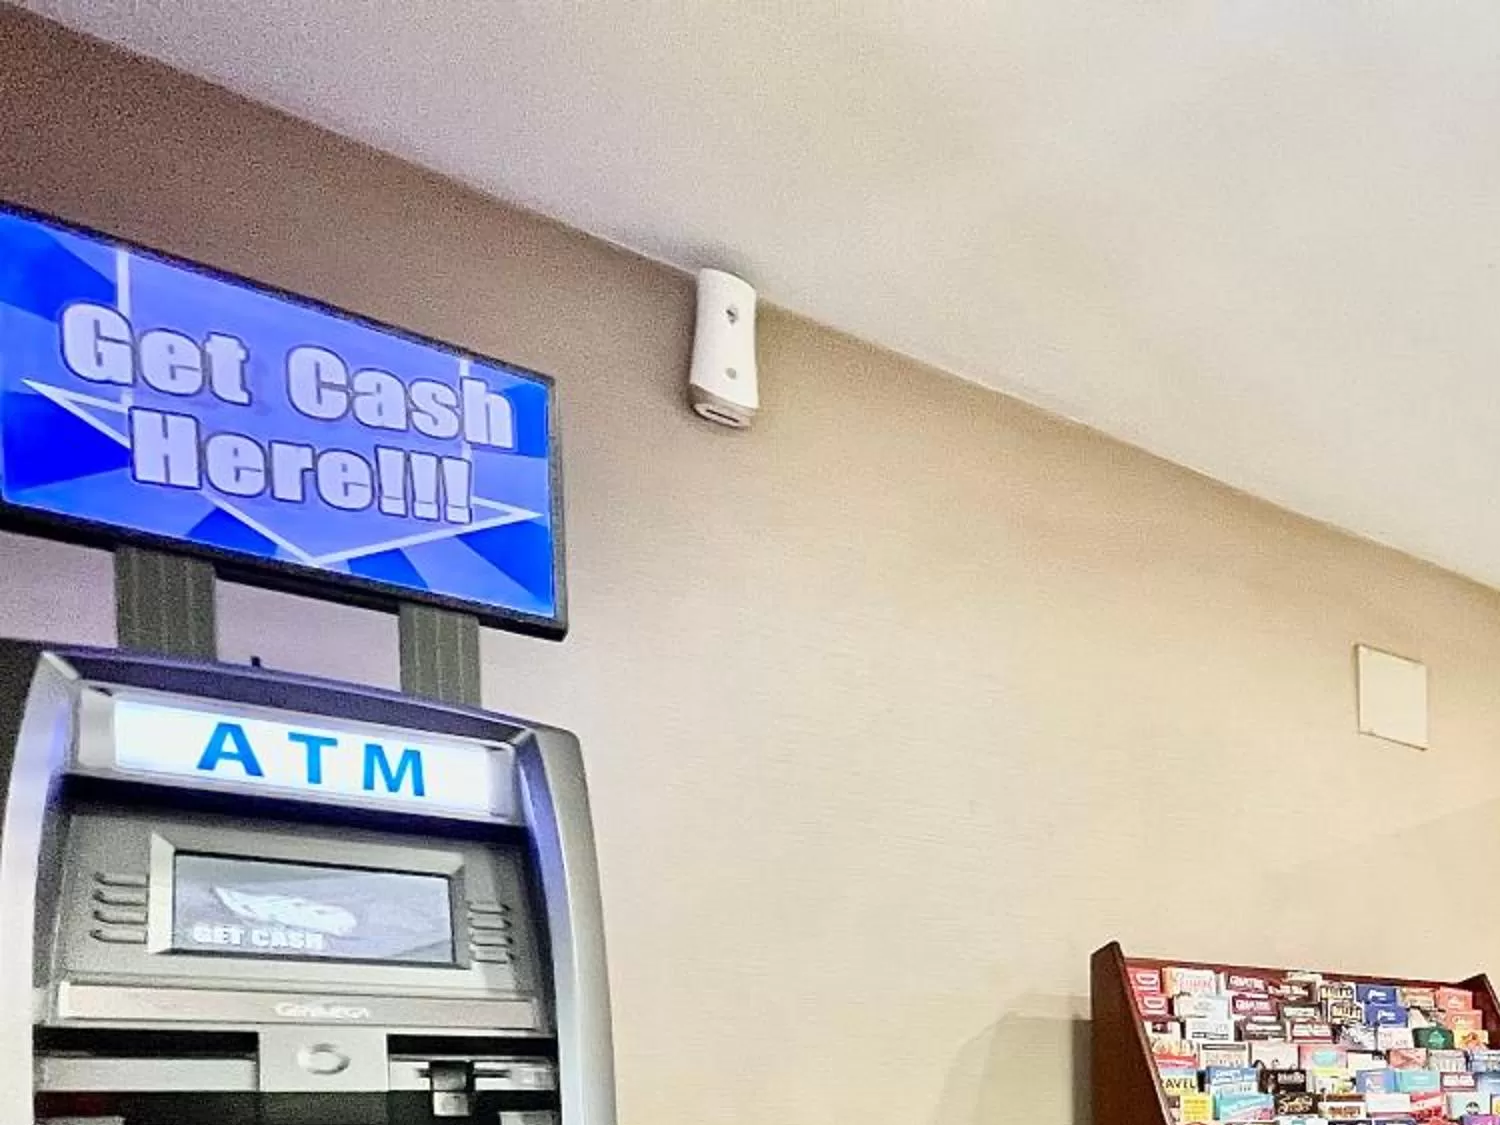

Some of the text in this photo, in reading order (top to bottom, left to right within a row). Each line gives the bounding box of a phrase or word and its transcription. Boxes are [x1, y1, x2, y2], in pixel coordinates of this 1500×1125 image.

[61, 302, 514, 449] Get Cash
[130, 406, 472, 524] Here!!!
[197, 721, 425, 797] ATM
[193, 923, 324, 952] GET CASH
